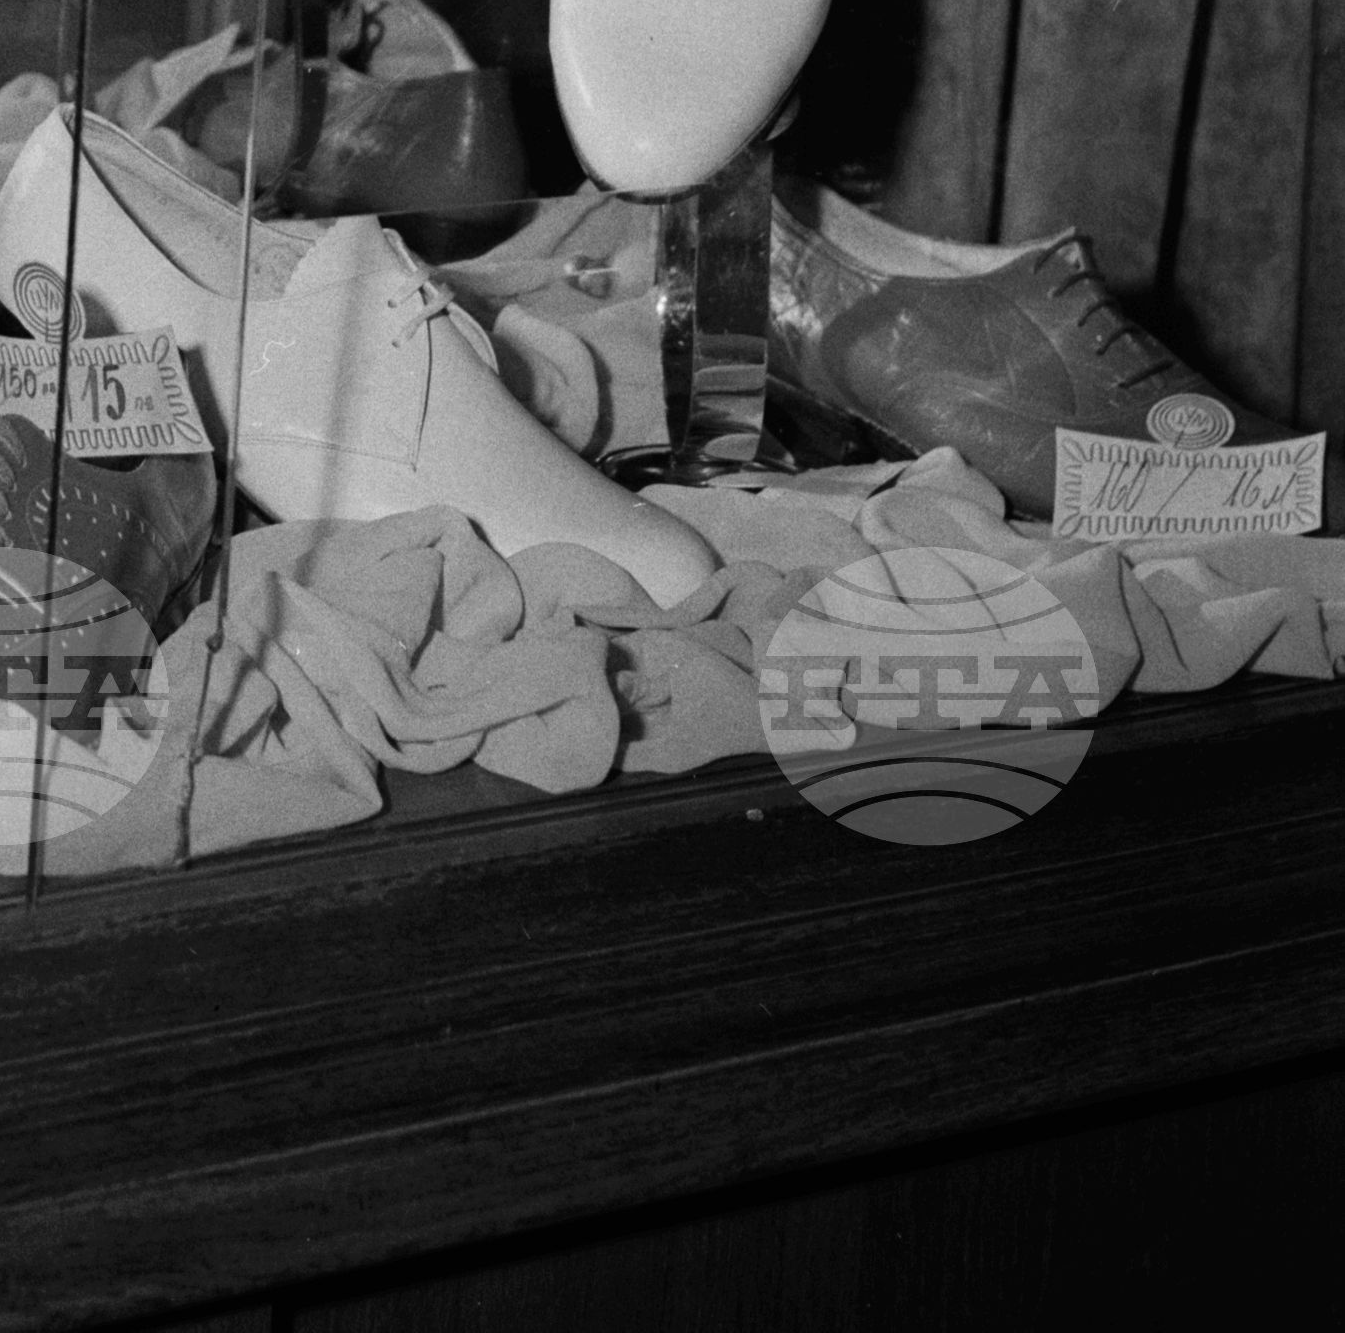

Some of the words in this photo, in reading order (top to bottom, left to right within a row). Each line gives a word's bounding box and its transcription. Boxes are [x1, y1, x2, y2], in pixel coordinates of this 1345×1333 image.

[80, 364, 127, 423] 15
[1089, 459, 1152, 513] 160
[1222, 467, 1265, 510] 16
